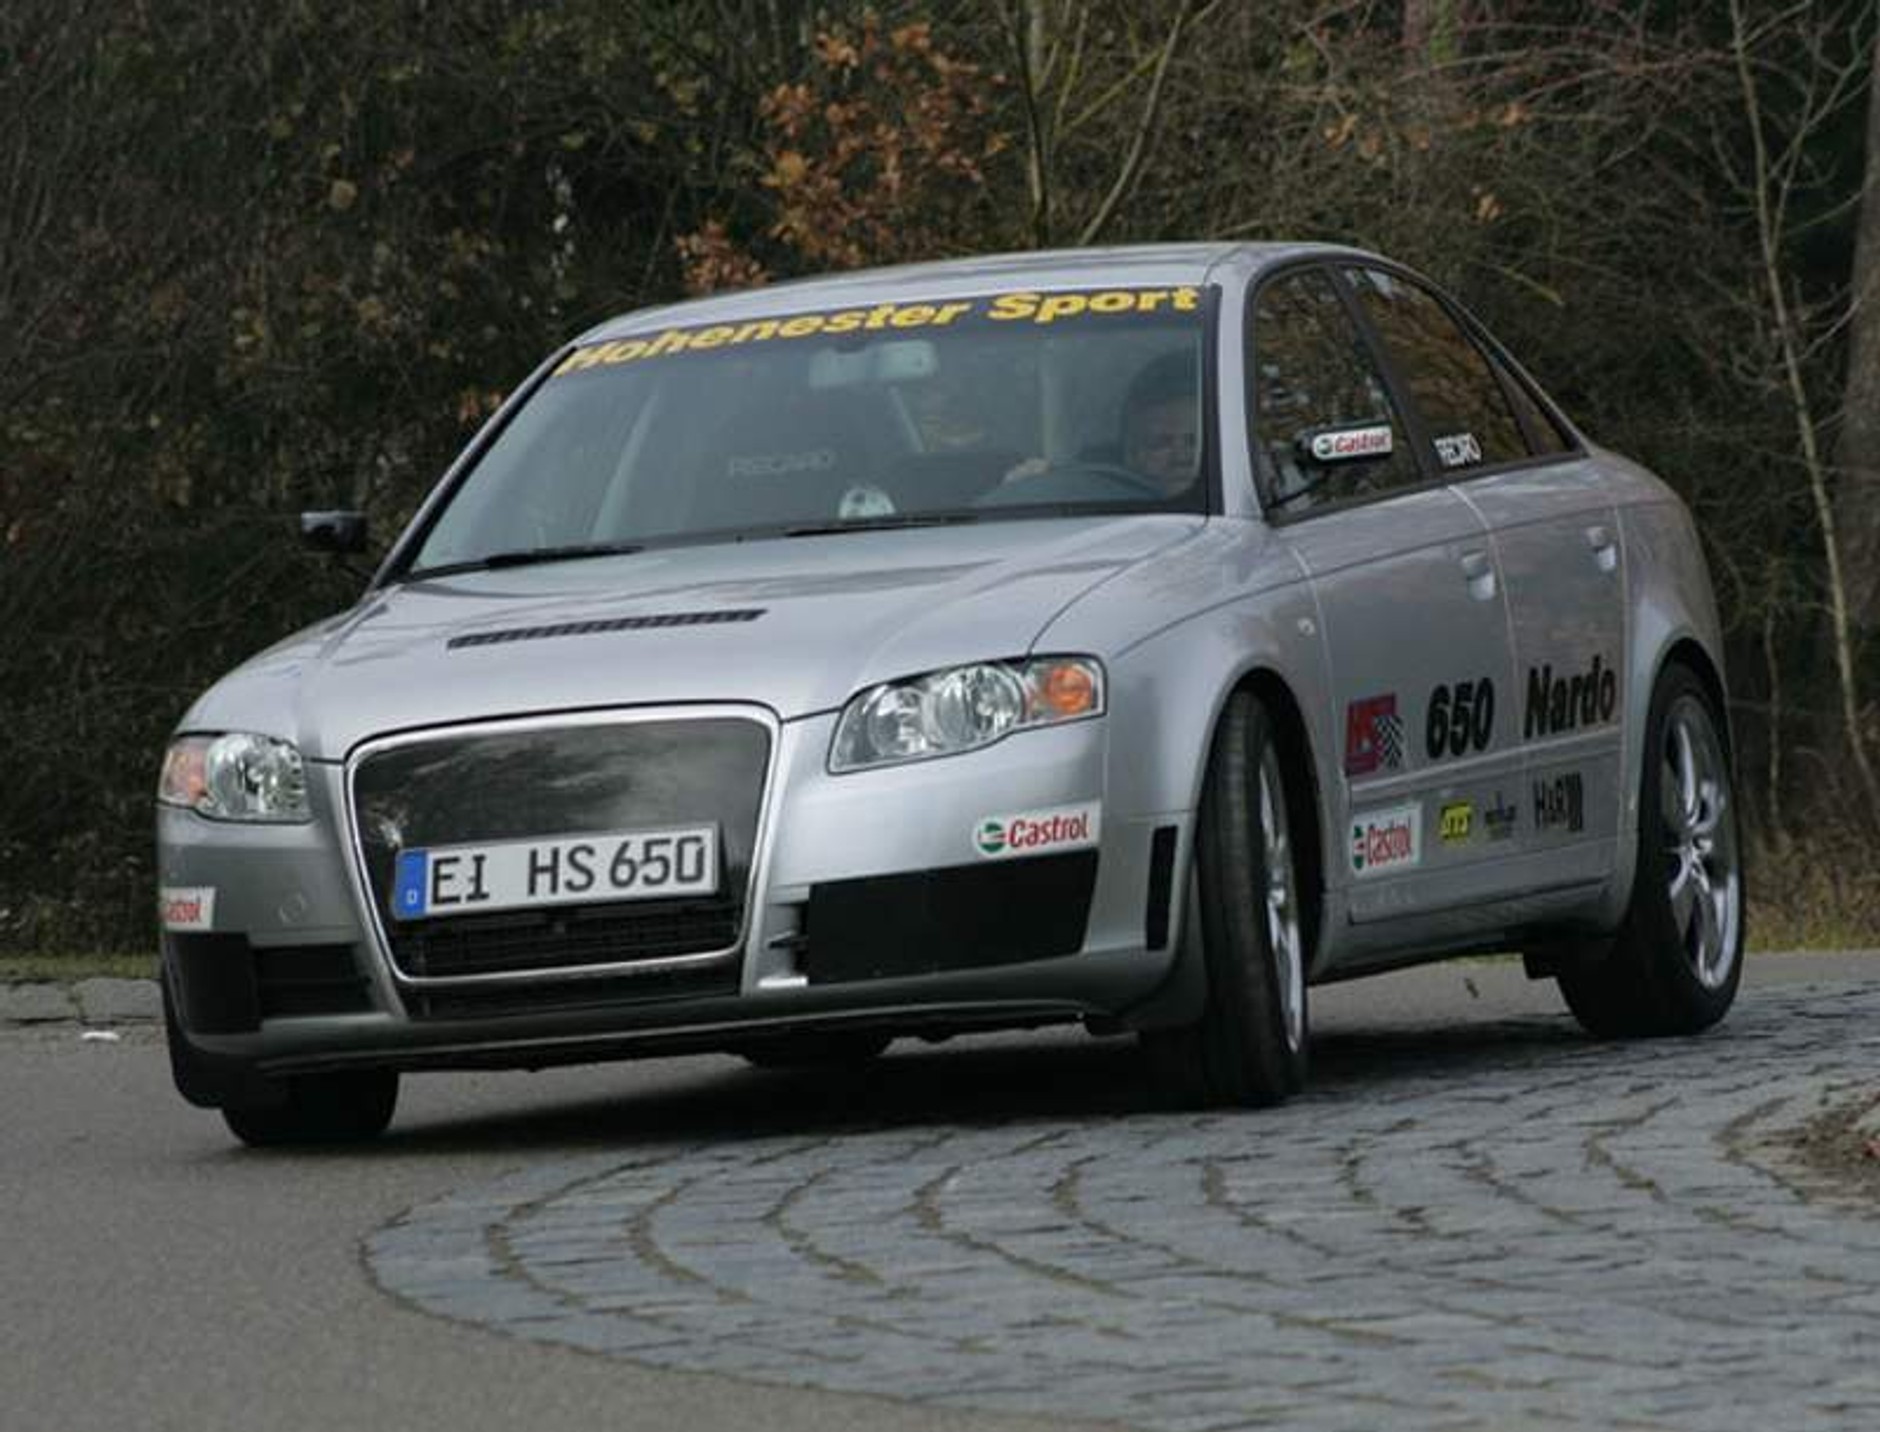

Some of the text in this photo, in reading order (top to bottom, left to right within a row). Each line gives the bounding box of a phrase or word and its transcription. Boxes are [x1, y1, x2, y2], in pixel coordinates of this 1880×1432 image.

[554, 286, 1199, 378] Hohenester Sport
[1426, 677, 1494, 758] 650
[1523, 655, 1617, 739] Nardo
[1008, 812, 1088, 848] Castrol
[1368, 816, 1411, 866] Castrol
[432, 855, 489, 904] EI
[527, 846, 595, 895] HS
[609, 836, 704, 888] 650
